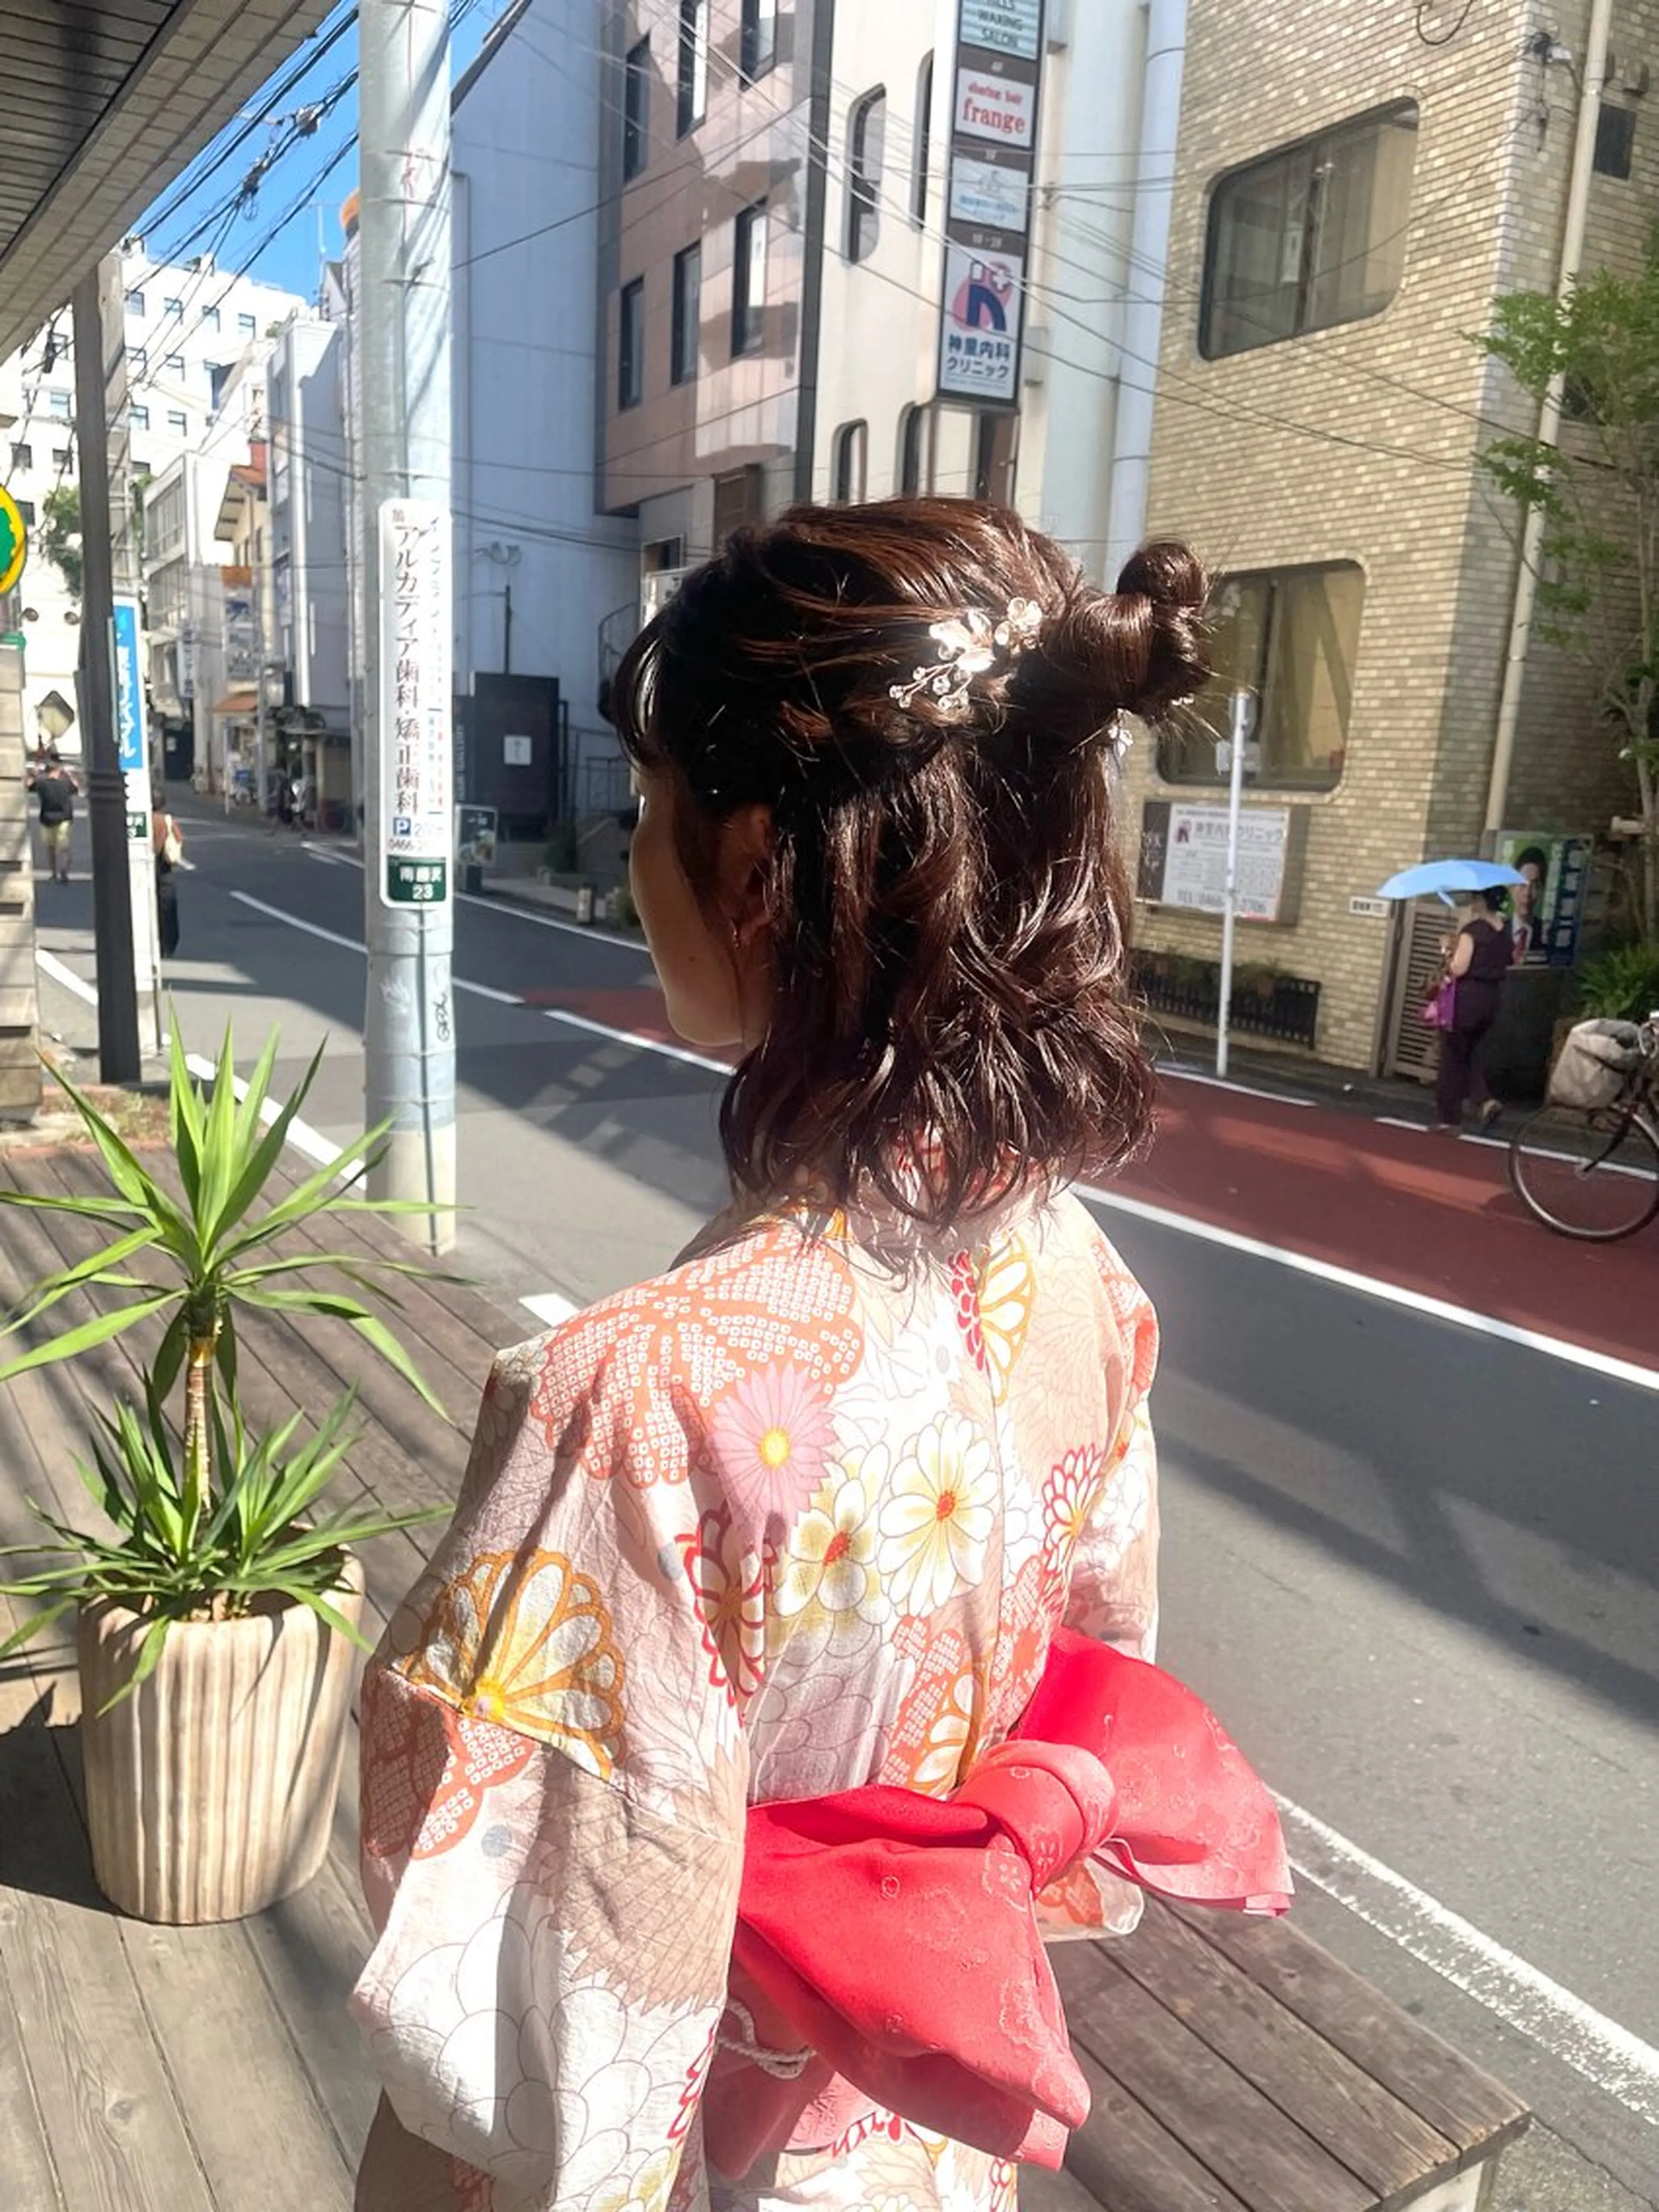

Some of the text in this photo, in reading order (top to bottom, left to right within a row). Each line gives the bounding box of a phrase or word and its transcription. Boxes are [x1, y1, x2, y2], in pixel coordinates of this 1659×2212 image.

[963, 98, 1025, 134] frange
[947, 356, 1009, 379] クリニック
[413, 884, 434, 900] 23
